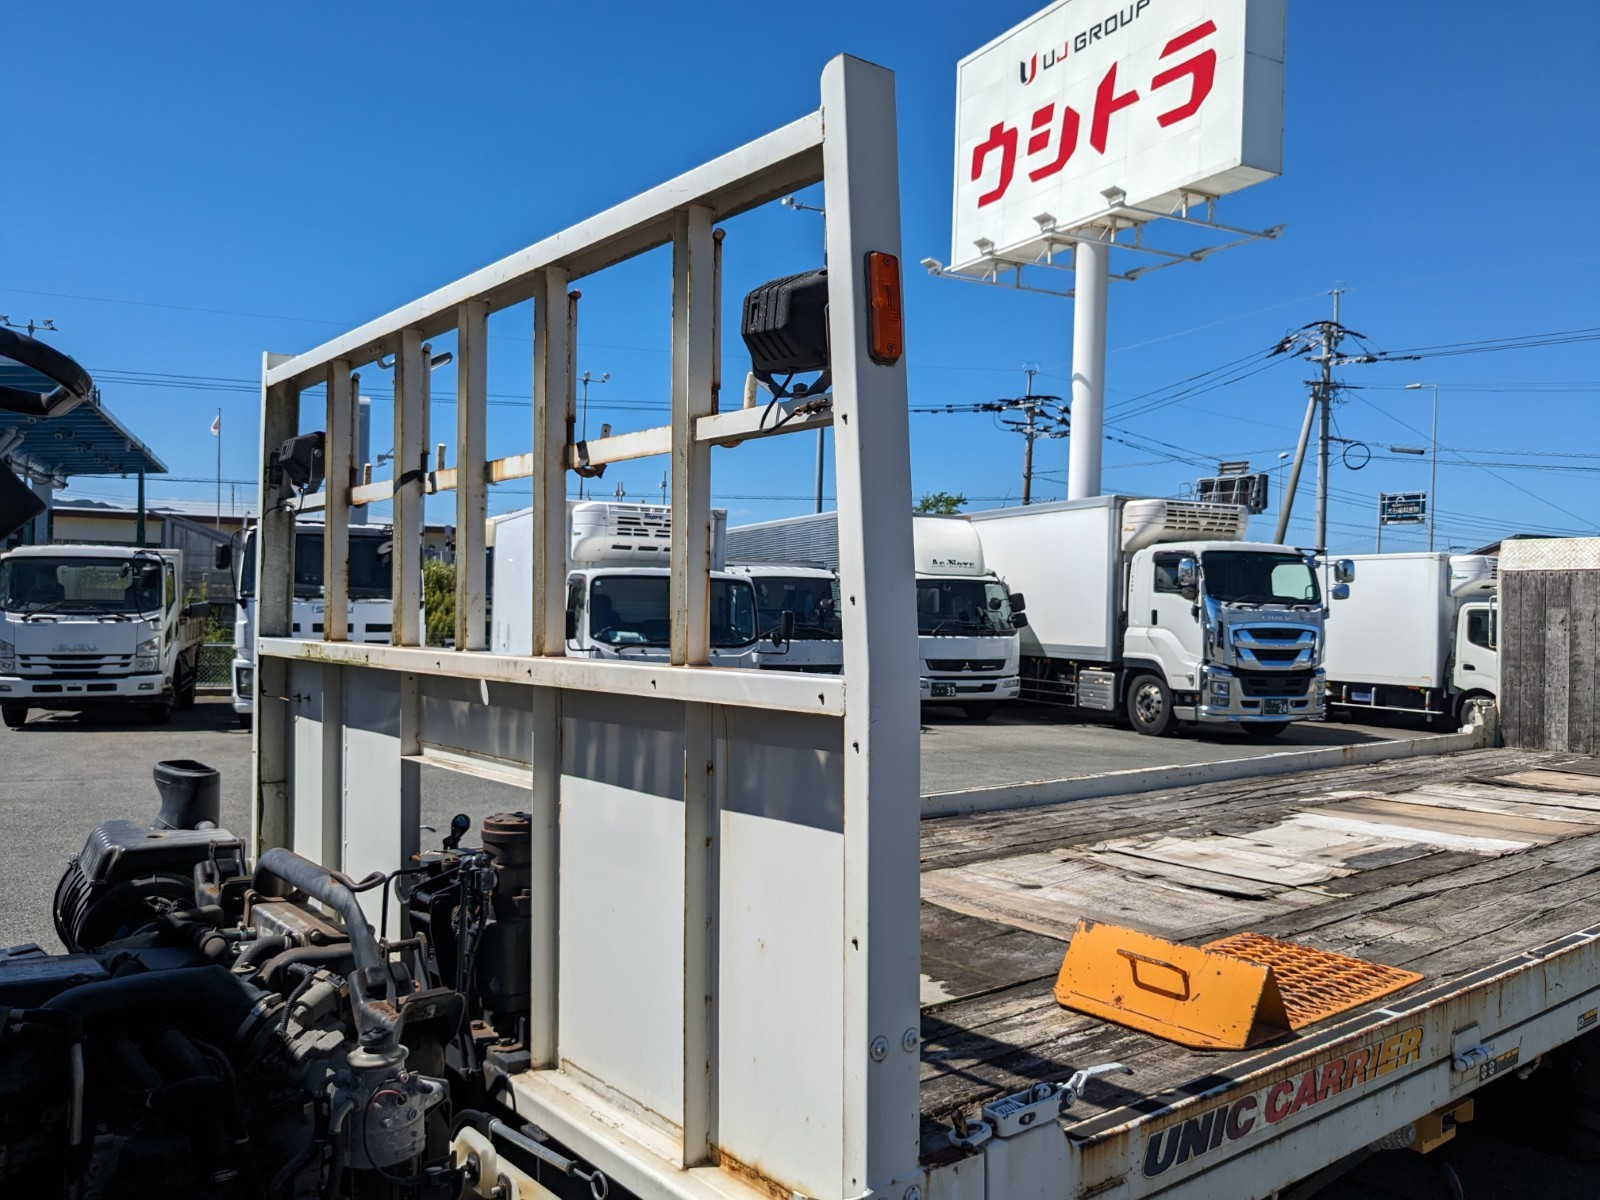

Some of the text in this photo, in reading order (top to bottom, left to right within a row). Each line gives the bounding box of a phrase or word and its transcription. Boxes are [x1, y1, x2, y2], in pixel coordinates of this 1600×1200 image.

[1042, 0, 1151, 71] UJ GROUP
[970, 19, 1218, 209] ウシトラ
[1143, 1026, 1424, 1178] UNIC CARRIER
